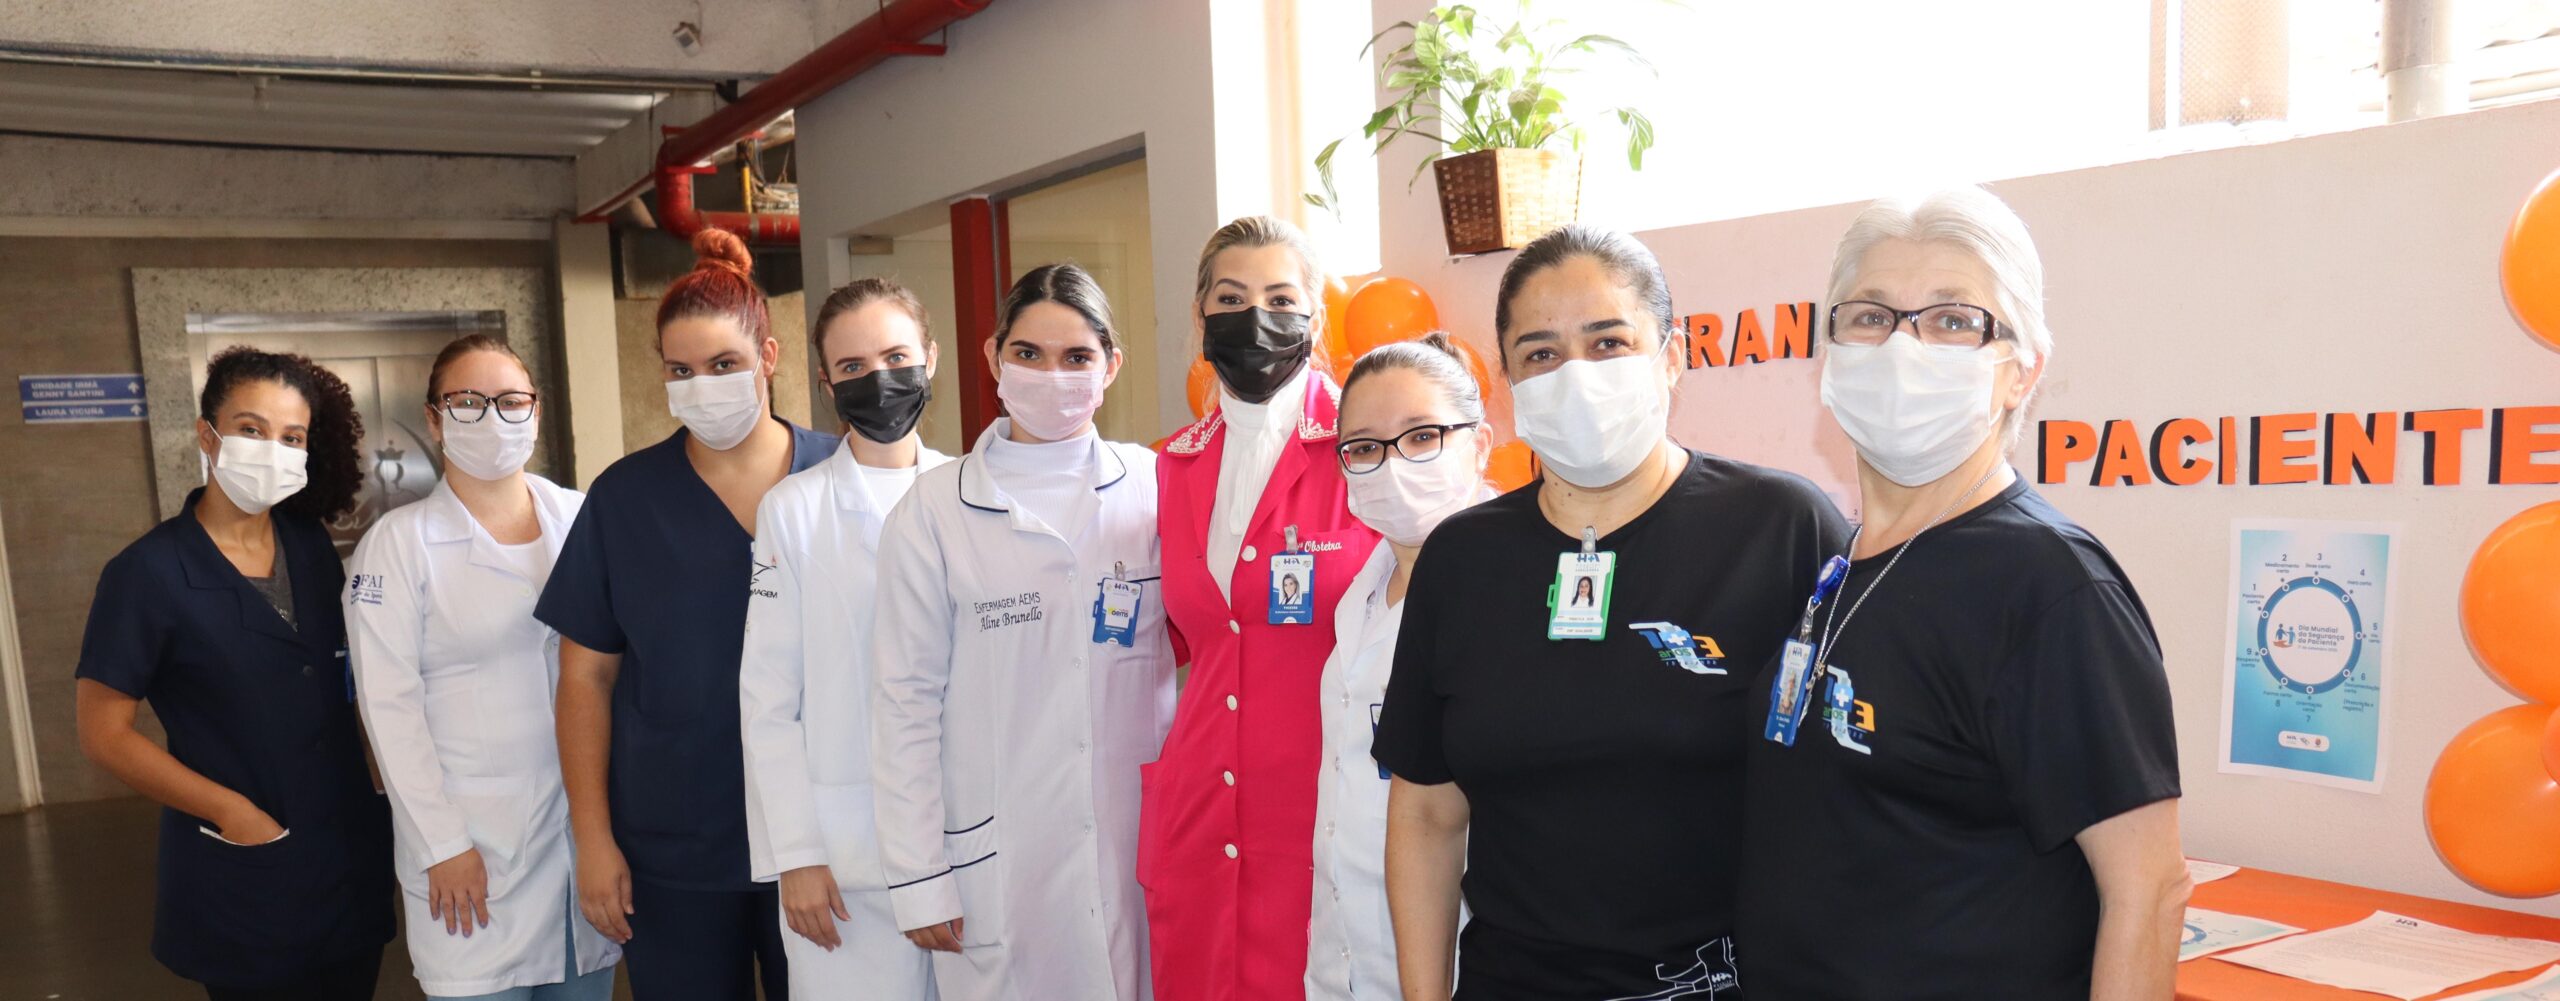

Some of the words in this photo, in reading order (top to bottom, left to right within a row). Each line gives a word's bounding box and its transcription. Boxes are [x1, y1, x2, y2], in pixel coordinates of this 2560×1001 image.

[1672, 301, 1816, 370] RAN
[31, 382, 72, 390] UNIDADE
[32, 391, 65, 399] GENNY
[67, 389, 105, 397] SANTINI
[35, 408, 67, 416] LAURA
[2037, 406, 2560, 487] PACIENTE
[2281, 553, 2288, 561] 2
[2316, 552, 2322, 561] 3
[2360, 568, 2365, 576] 4
[360, 574, 383, 588] FAI
[2252, 583, 2257, 591] 1
[974, 597, 1016, 614] ENFERMAGEM
[1019, 591, 1041, 606] AEMS
[980, 614, 1001, 632] Aline
[1002, 606, 1042, 626] Brunello
[2311, 625, 2338, 634] Mundial
[2372, 622, 2378, 631] 5
[2308, 632, 2345, 641] Segurança
[2307, 638, 2337, 646] Paciente
[2360, 672, 2366, 681] 6
